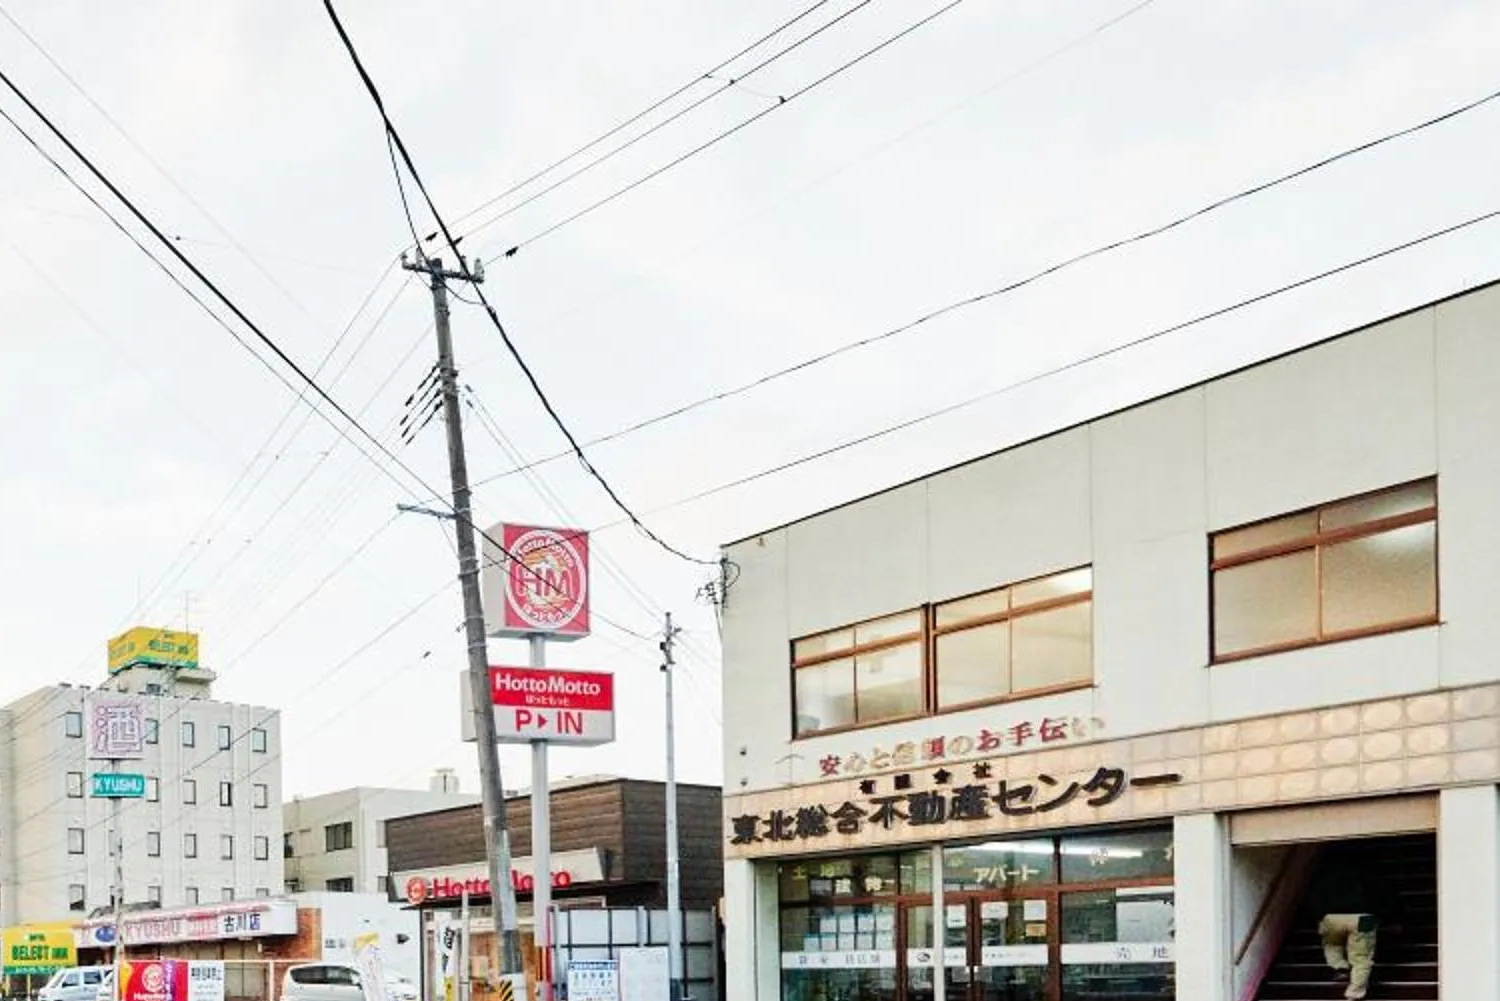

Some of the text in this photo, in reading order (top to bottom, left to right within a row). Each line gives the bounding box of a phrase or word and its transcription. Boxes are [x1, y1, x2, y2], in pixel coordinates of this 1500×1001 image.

[495, 672, 601, 696] HottoMotto
[515, 708, 584, 735] P IN
[730, 766, 1184, 846] 東北総合不動産センター
[223, 913, 261, 933] 古川店
